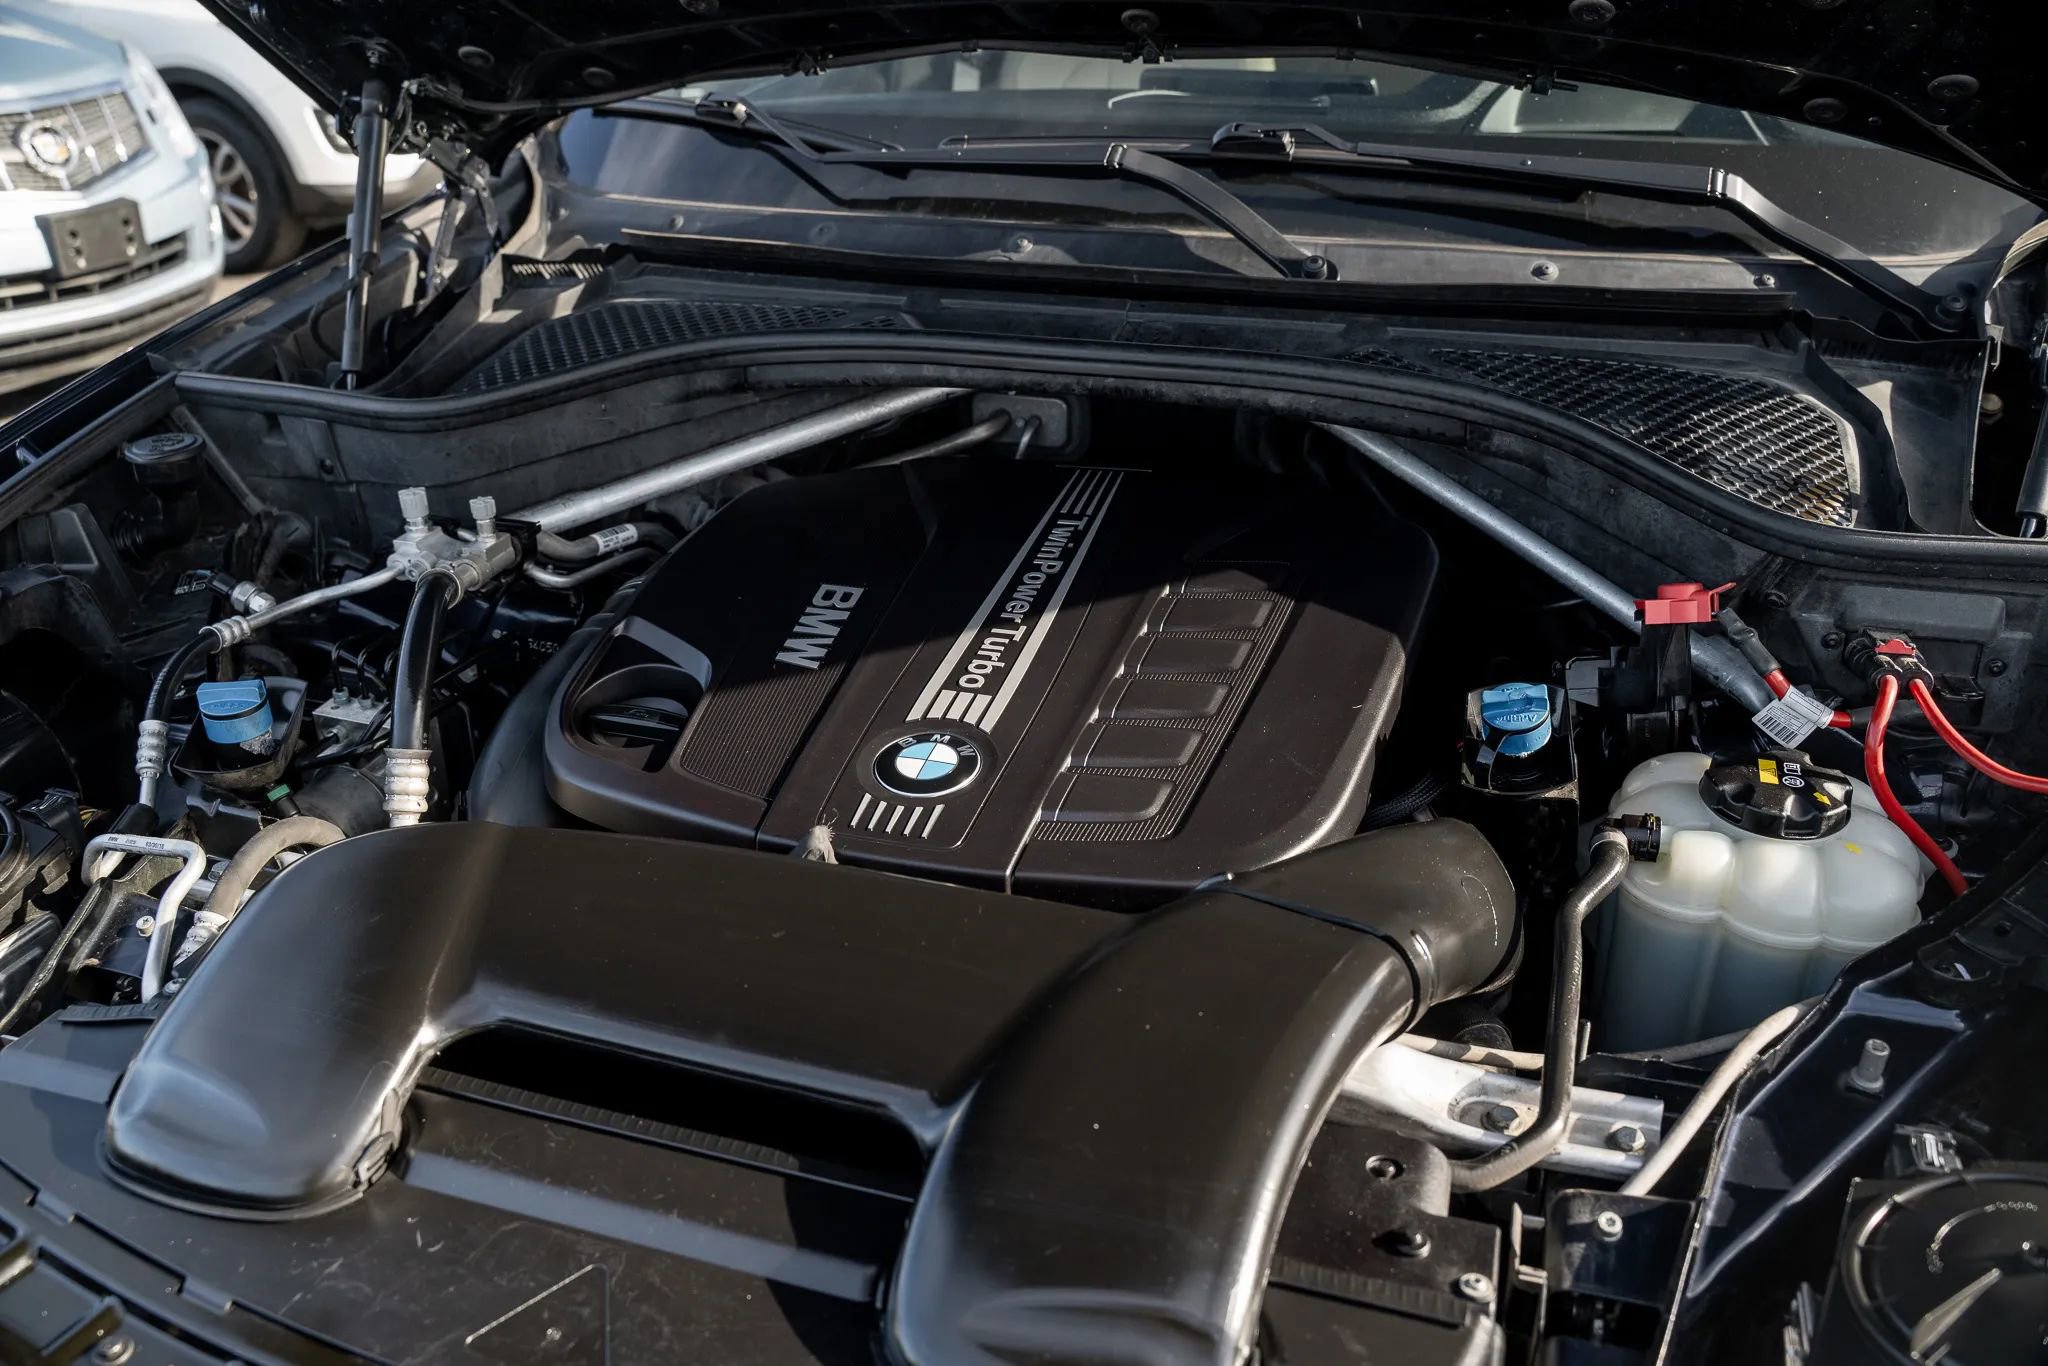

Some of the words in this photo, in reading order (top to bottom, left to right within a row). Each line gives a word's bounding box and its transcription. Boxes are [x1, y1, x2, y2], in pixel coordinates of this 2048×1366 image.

[1000, 516, 1089, 623] TwinPower
[775, 584, 864, 669] BMW
[958, 625, 1028, 689] Turbo
[898, 734, 975, 756] BMW
[1496, 713, 1538, 724] AdBlue
